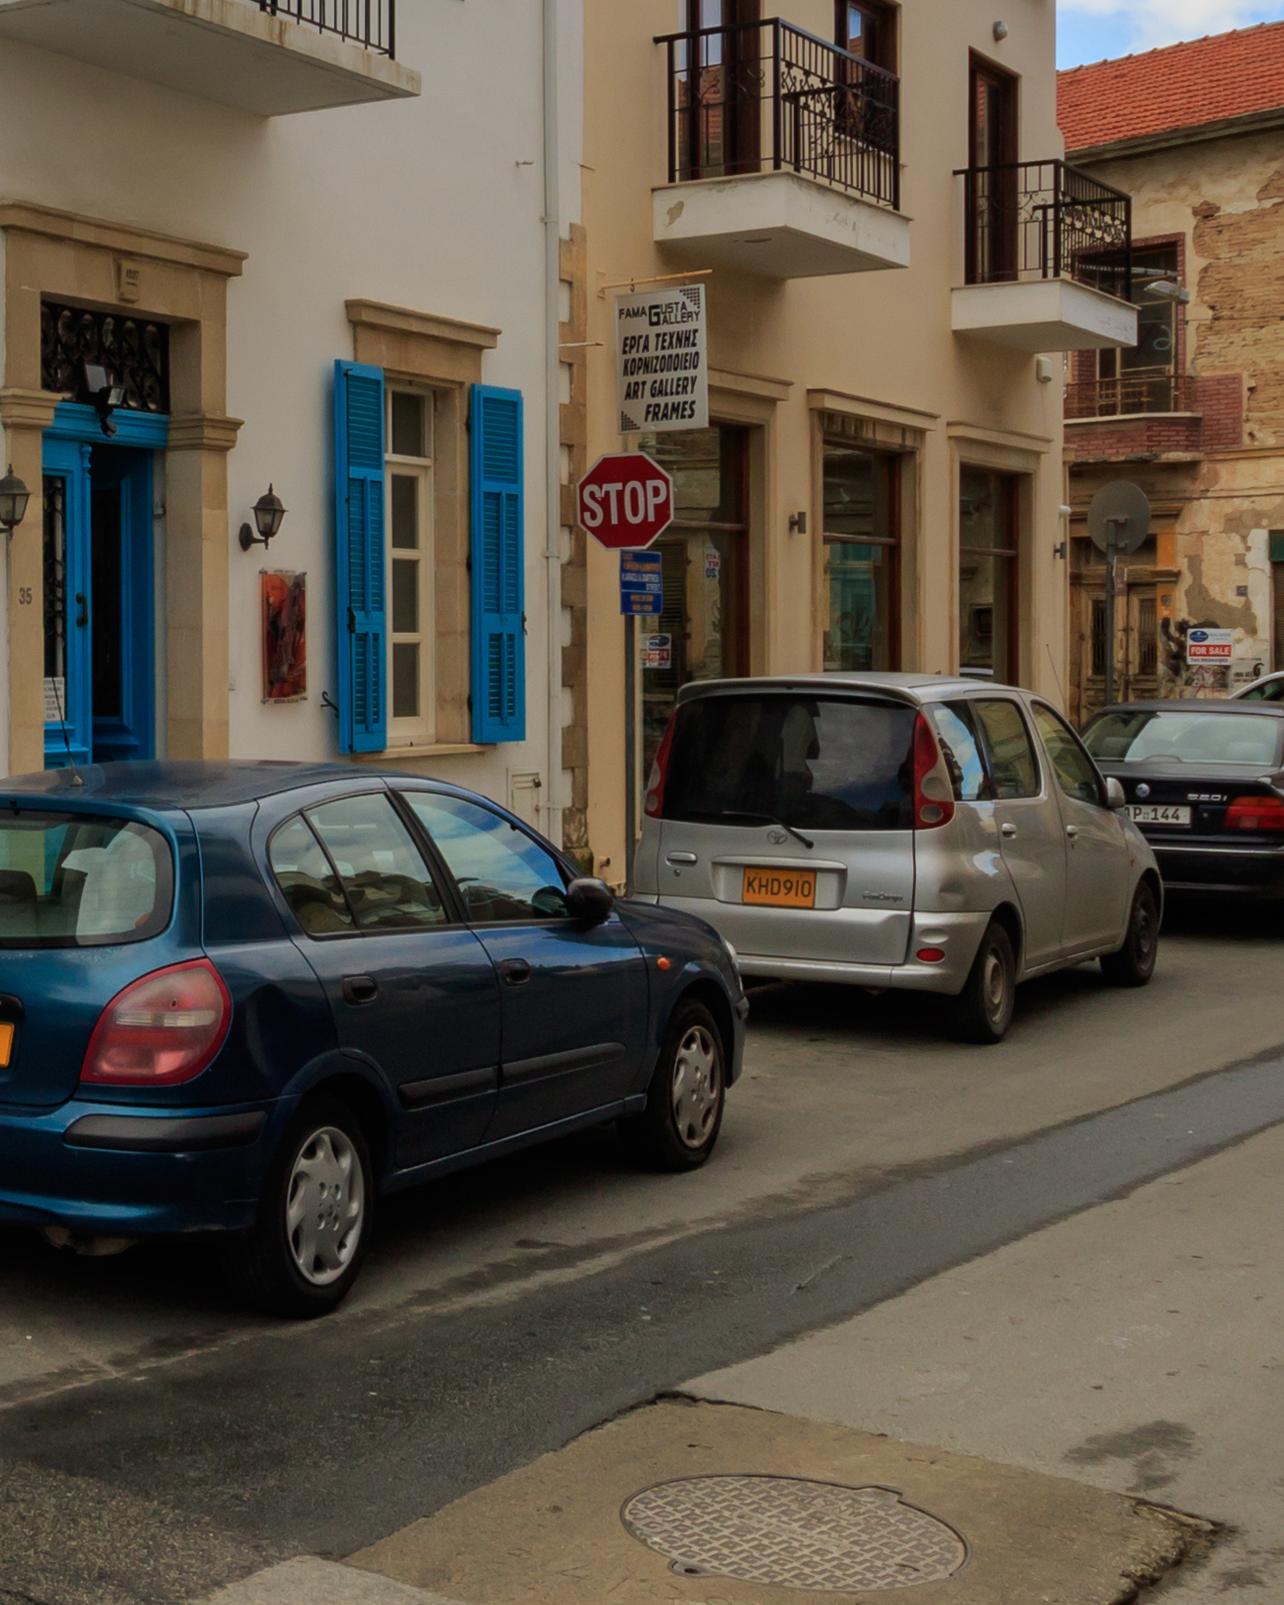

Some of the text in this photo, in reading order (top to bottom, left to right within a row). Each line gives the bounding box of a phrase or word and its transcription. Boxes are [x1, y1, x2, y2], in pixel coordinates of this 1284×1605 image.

[622, 328, 699, 355] ΕΡΓΑ ΤΕΧΝΗΣ
[623, 351, 700, 377] ΚΟΡΝΙΖΟΠΟΙΕΙΟ
[624, 375, 698, 400] ART GALLERY
[644, 400, 696, 423] FRAMES
[583, 479, 668, 528] STOP
[19, 587, 33, 605] 35
[1190, 646, 1230, 655] FOR SALE
[1150, 807, 1180, 821] 144
[745, 876, 812, 898] KHD910
